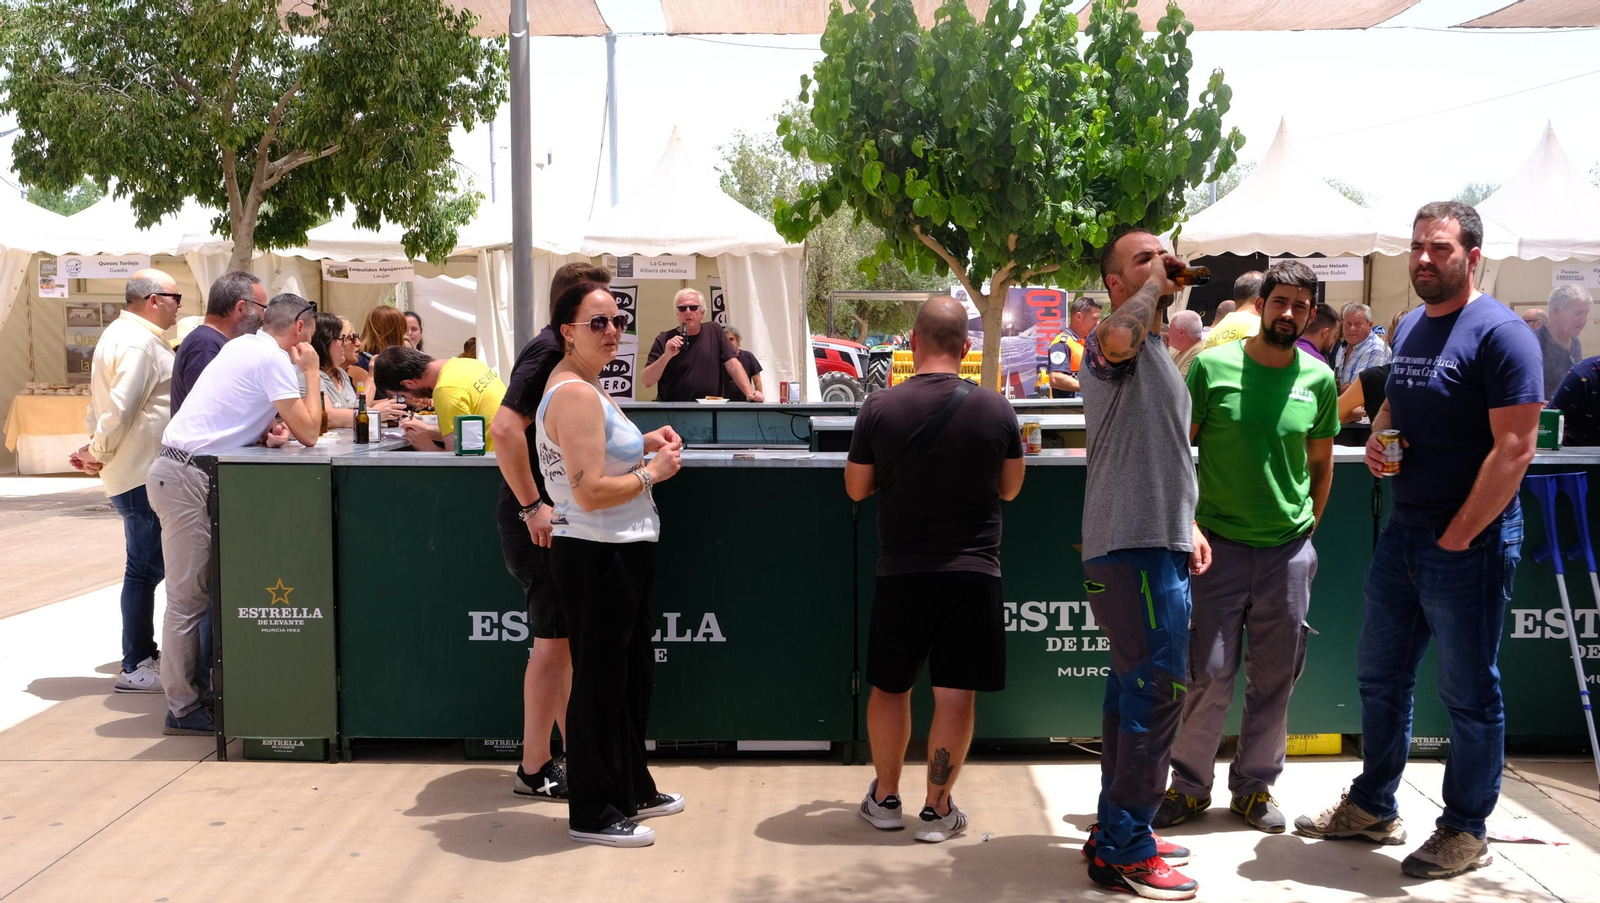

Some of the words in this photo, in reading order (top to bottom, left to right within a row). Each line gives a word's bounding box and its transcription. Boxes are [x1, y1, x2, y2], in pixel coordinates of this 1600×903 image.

[603, 363, 627, 372] NDA
[603, 380, 627, 390] ERO
[237, 607, 324, 619] ESTRELLA
[1046, 637, 1077, 652] DE
[262, 739, 305, 747] ESTRELLA
